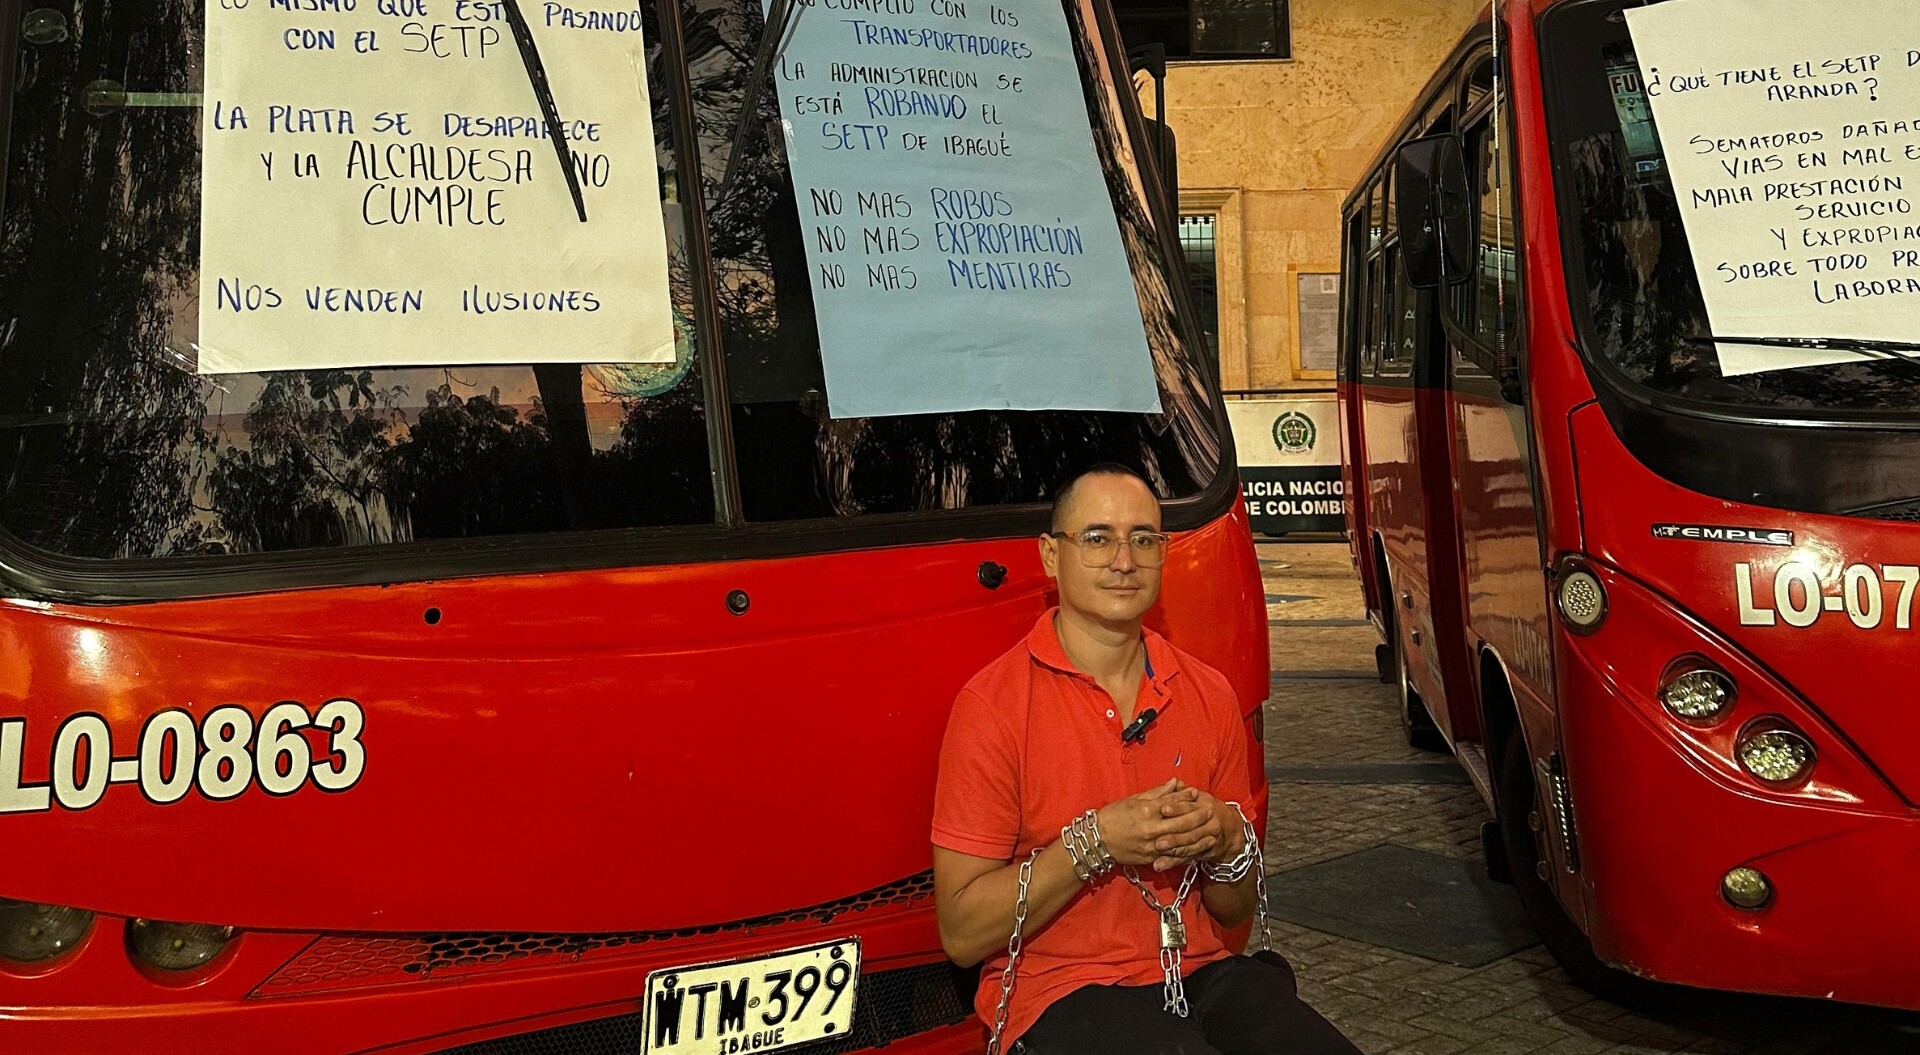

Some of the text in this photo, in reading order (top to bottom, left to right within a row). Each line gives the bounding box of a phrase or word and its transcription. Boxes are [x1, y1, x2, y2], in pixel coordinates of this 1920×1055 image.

[543, 3, 642, 32] PASANDO
[931, 0, 968, 19] CON
[990, 5, 1020, 28] LOS
[284, 22, 500, 58] CON EL SETP
[840, 19, 1033, 60] TRANSPORTADORES
[781, 54, 1023, 94] LA ADMINISTRACION SE
[1716, 67, 1782, 87] TIENE
[1821, 54, 1881, 75] SETP
[214, 101, 249, 130] LA
[269, 105, 355, 134] PLATA
[372, 112, 412, 136] SE
[795, 86, 1003, 125] ESTÁ ROBANDO EL
[821, 121, 1012, 157] SETP DE IBAGUÉ
[260, 140, 610, 188] Y LA ALCALDESA NO
[1721, 154, 1784, 180] VIAS
[1797, 152, 1828, 170] EN
[1842, 147, 1893, 167] MAL
[810, 187, 1013, 220] NO MAS ROBOS
[1764, 175, 1903, 201] PRESTACIÓN
[363, 183, 506, 227] CUMPLE
[1795, 198, 1911, 220] SERVICIO
[816, 216, 1084, 255] NO MAS EXPROPIACIÓN
[1770, 228, 1787, 250] Y
[820, 258, 1072, 291] NO MAS MENTIRAS
[1716, 261, 1798, 283] SOBRE
[1807, 254, 1868, 273] TODO
[305, 286, 424, 314] VENDEN
[463, 284, 602, 313] ILUSIONES
[719, 1027, 785, 1055] IBAGUE
